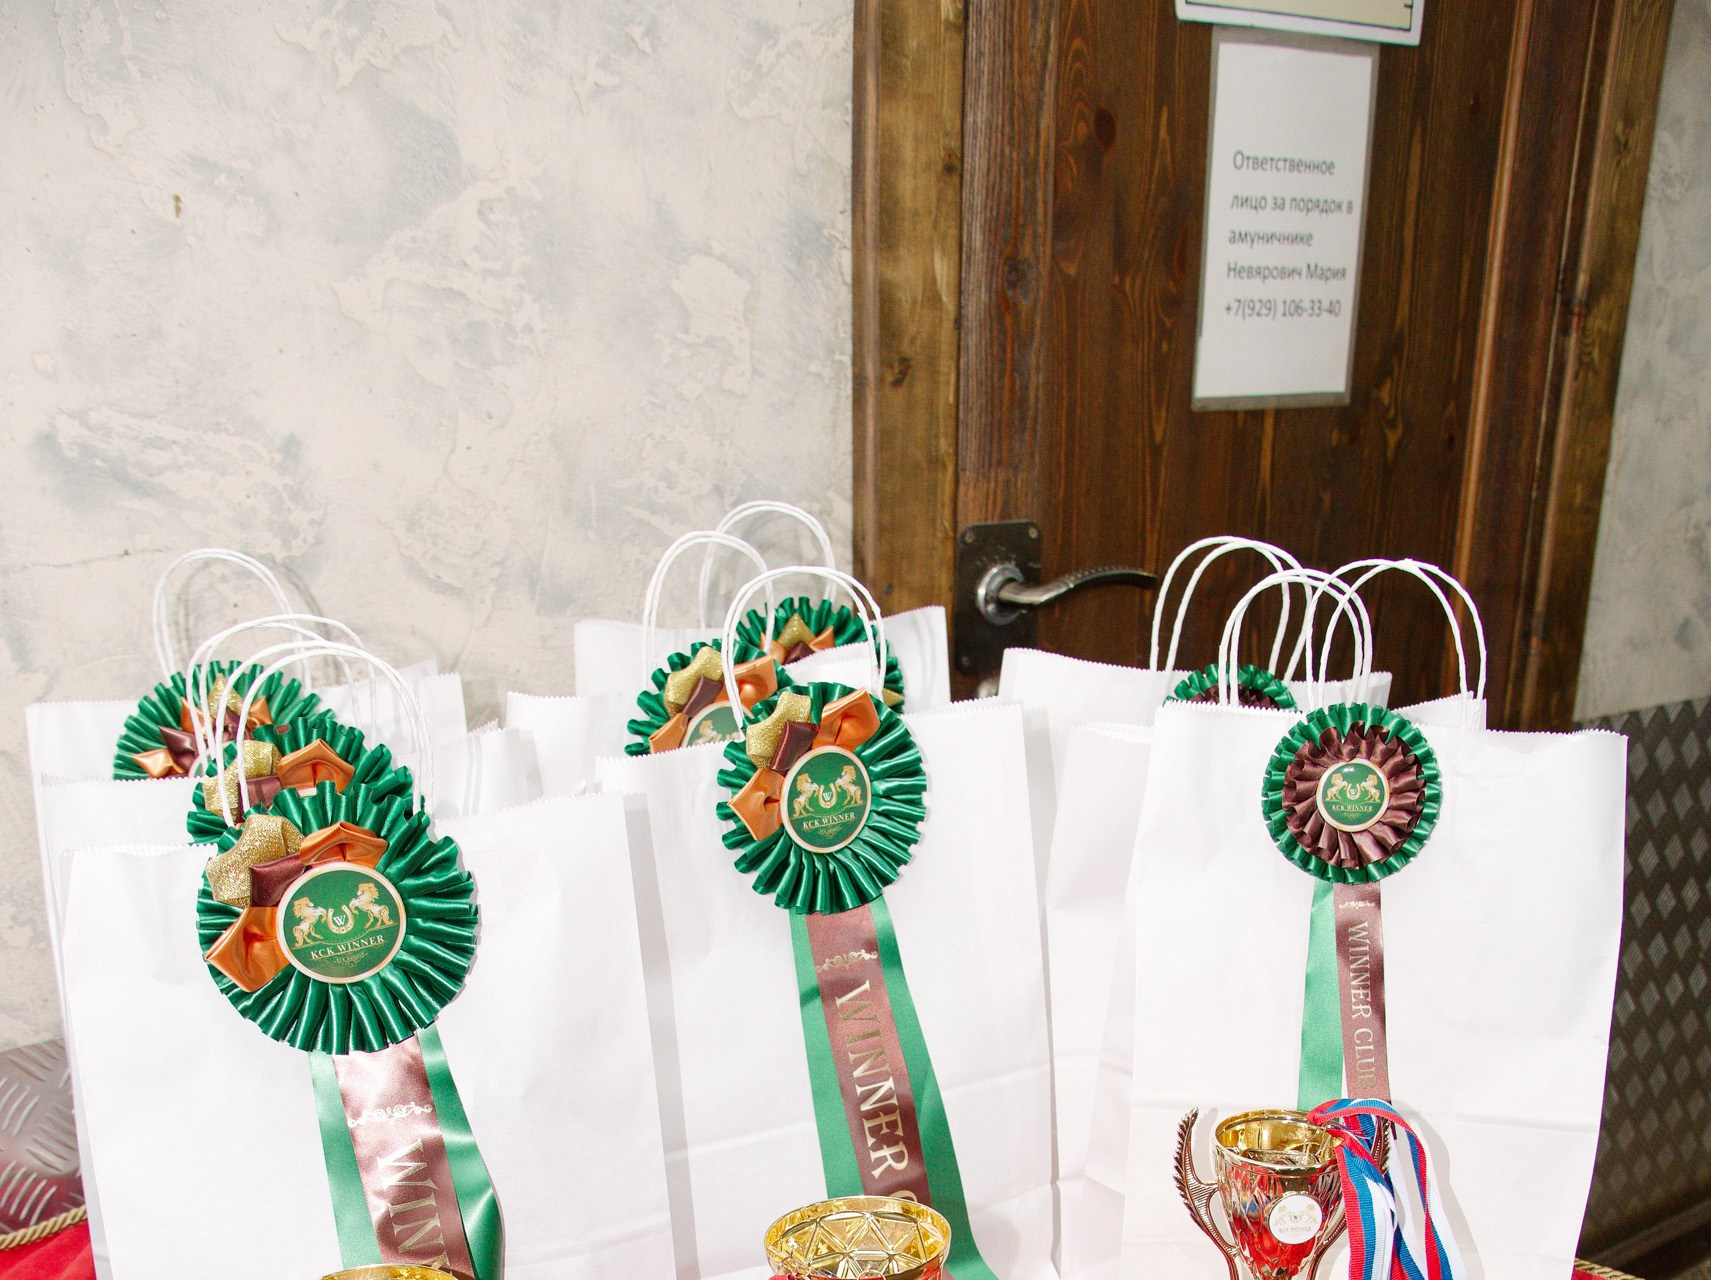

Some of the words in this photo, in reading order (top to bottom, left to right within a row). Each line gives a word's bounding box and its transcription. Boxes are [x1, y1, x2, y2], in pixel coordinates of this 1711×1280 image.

[1233, 150, 1335, 175] Ответственное
[1231, 194, 1267, 214] лицо
[1271, 196, 1286, 211] за
[1290, 198, 1344, 217] порядок
[1347, 202, 1354, 215] в
[1228, 229, 1314, 250] амуничнике
[1226, 261, 1302, 284] Невярович
[1305, 264, 1347, 284] Мария
[1224, 299, 1277, 320] +7(929)
[1282, 299, 1342, 318] 106-33-40
[822, 812, 855, 825] WINNER
[333, 914, 346, 926] W
[336, 934, 385, 953] WINNER
[1348, 921, 1372, 1020] WINNER
[1354, 1028, 1378, 1091] CLUB
[835, 979, 910, 1180] WINNER
